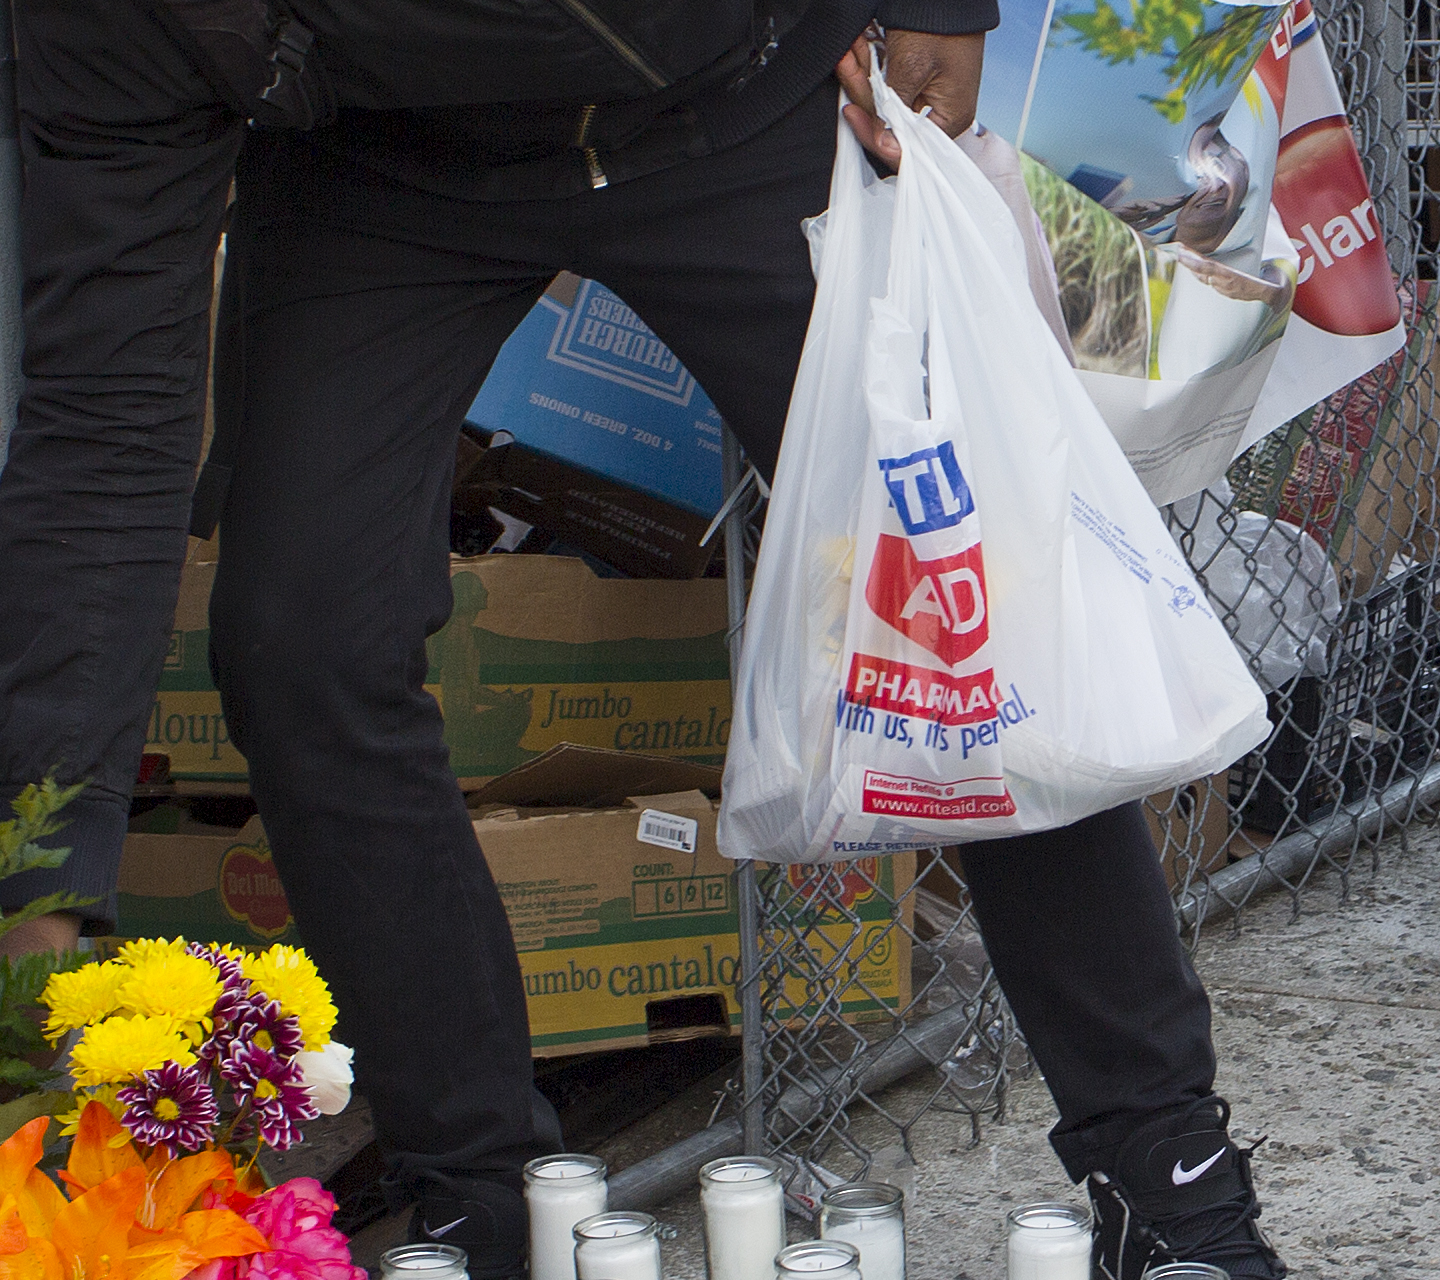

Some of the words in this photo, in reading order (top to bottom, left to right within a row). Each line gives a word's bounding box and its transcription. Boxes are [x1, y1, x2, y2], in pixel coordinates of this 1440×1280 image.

[577, 317, 679, 374] CHURCH
[528, 391, 581, 419] ONIONS
[583, 409, 628, 436] GREEN
[631, 426, 662, 450] DOZ.
[662, 439, 675, 452] 4
[541, 688, 633, 729] Jumbo
[884, 714, 913, 749] us,
[869, 776, 908, 792] Internet
[871, 797, 1014, 816] www.riteaid.com
[833, 841, 883, 852] PLEASE
[632, 862, 674, 879] COUNT:
[663, 885, 676, 904] 6
[685, 883, 698, 902] 9
[705, 881, 724, 901] 12
[522, 959, 602, 998] umbo
